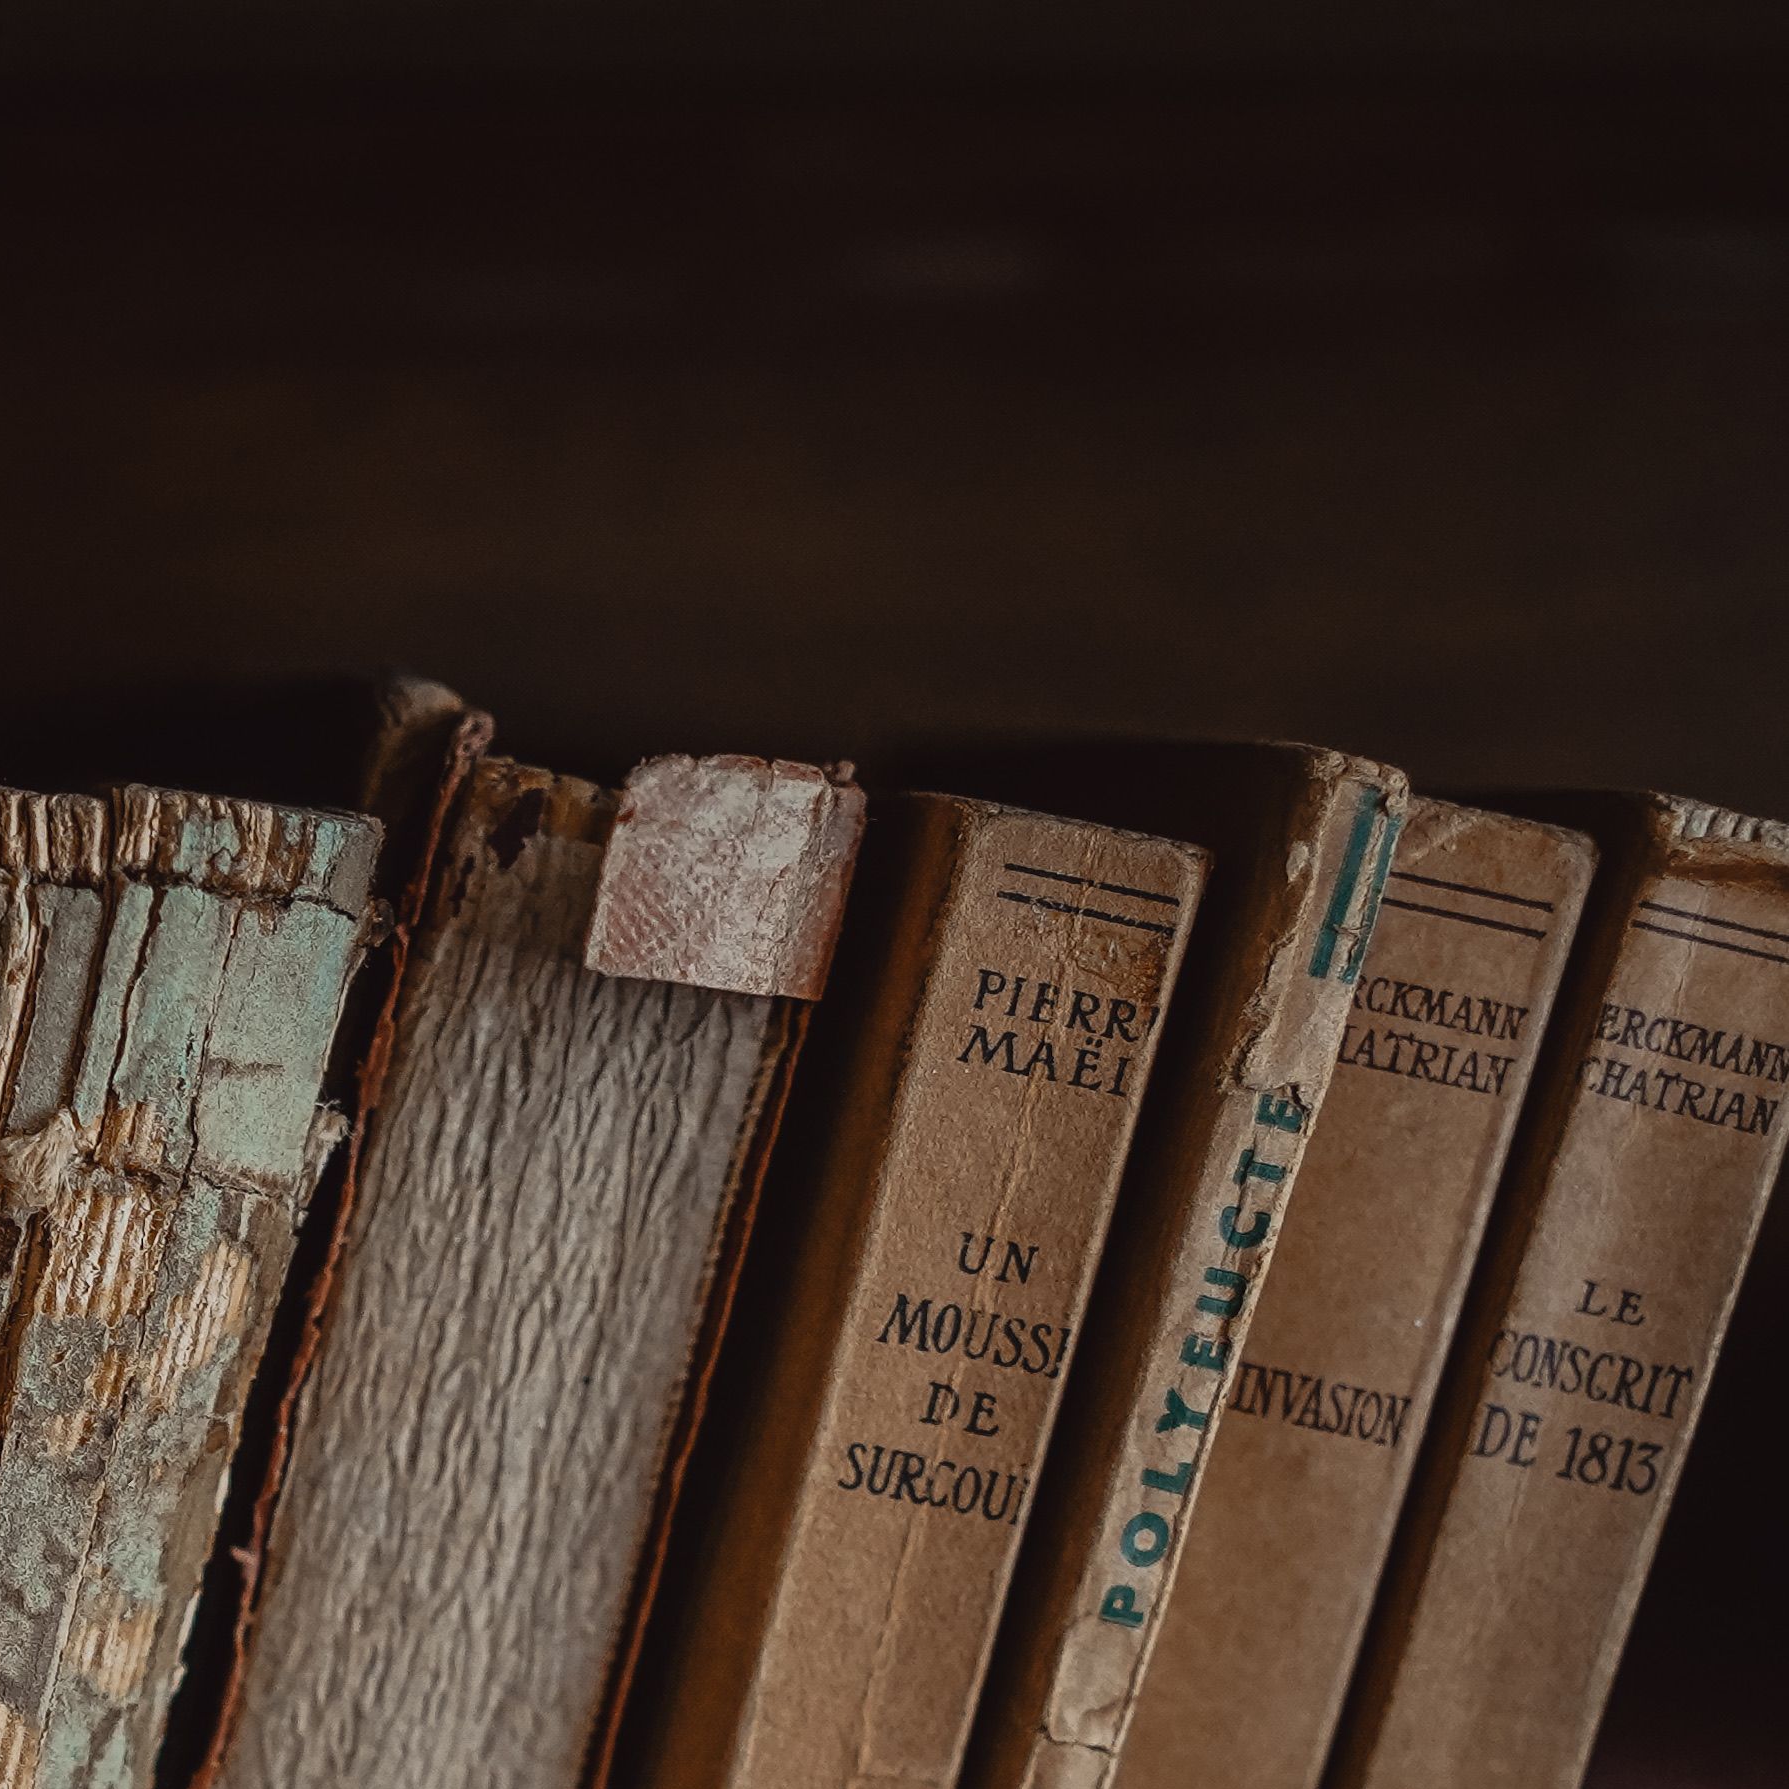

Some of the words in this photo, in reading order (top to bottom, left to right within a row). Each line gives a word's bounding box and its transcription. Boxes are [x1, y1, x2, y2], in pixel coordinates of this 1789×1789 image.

[973, 969, 1161, 1043] PIERR
[1352, 974, 1529, 1041] RCKMANN
[1576, 1056, 1779, 1137] CHATRIAN
[959, 1231, 1039, 1284] UN
[1575, 1279, 1645, 1326] LE
[1098, 1092, 1304, 1629] POLYEUCTE
[1489, 1328, 1693, 1419] CONSCRIT
[919, 1381, 999, 1437] DE
[1470, 1403, 1543, 1468] DE
[1555, 1425, 1663, 1495] 1813
